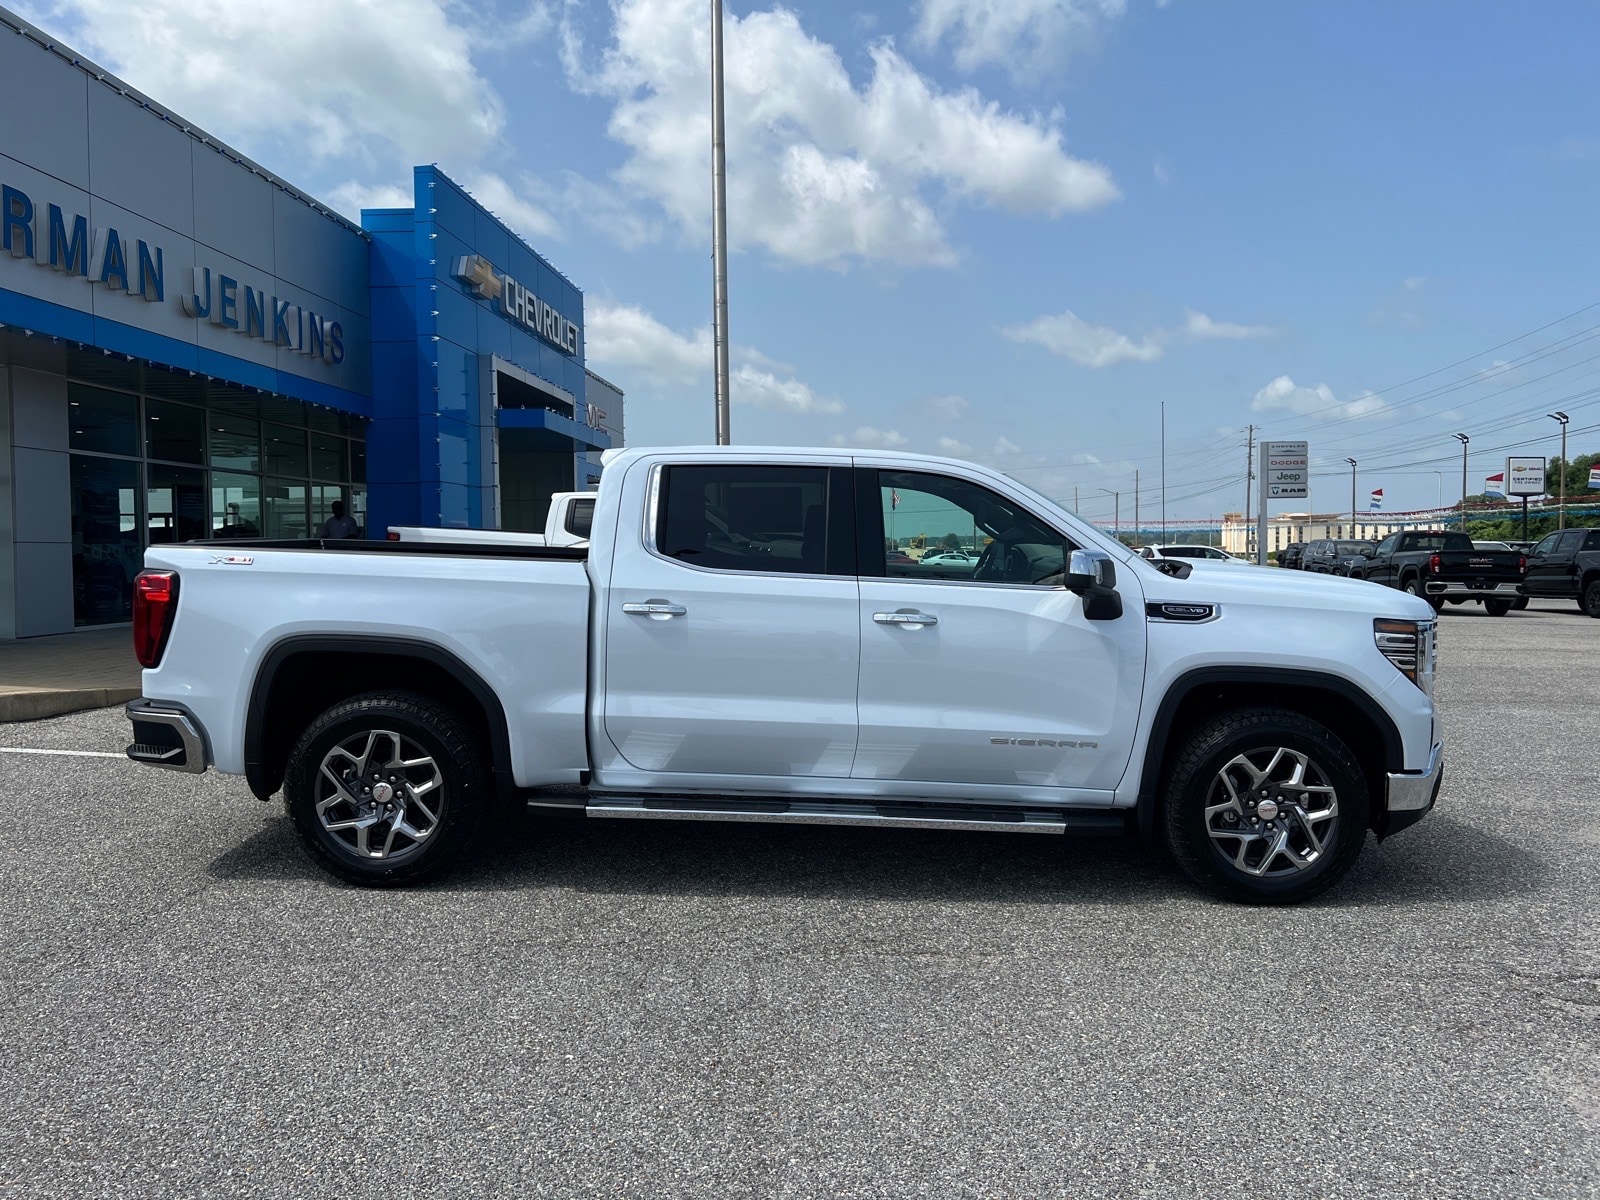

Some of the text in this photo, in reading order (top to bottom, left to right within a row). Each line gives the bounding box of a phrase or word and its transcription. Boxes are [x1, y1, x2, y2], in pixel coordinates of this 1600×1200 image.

[1, 183, 345, 364] RMAN JENKINS
[503, 274, 580, 357] CHEVROLET
[1276, 472, 1301, 481] Jeep
[990, 737, 1098, 749] SIERRA
